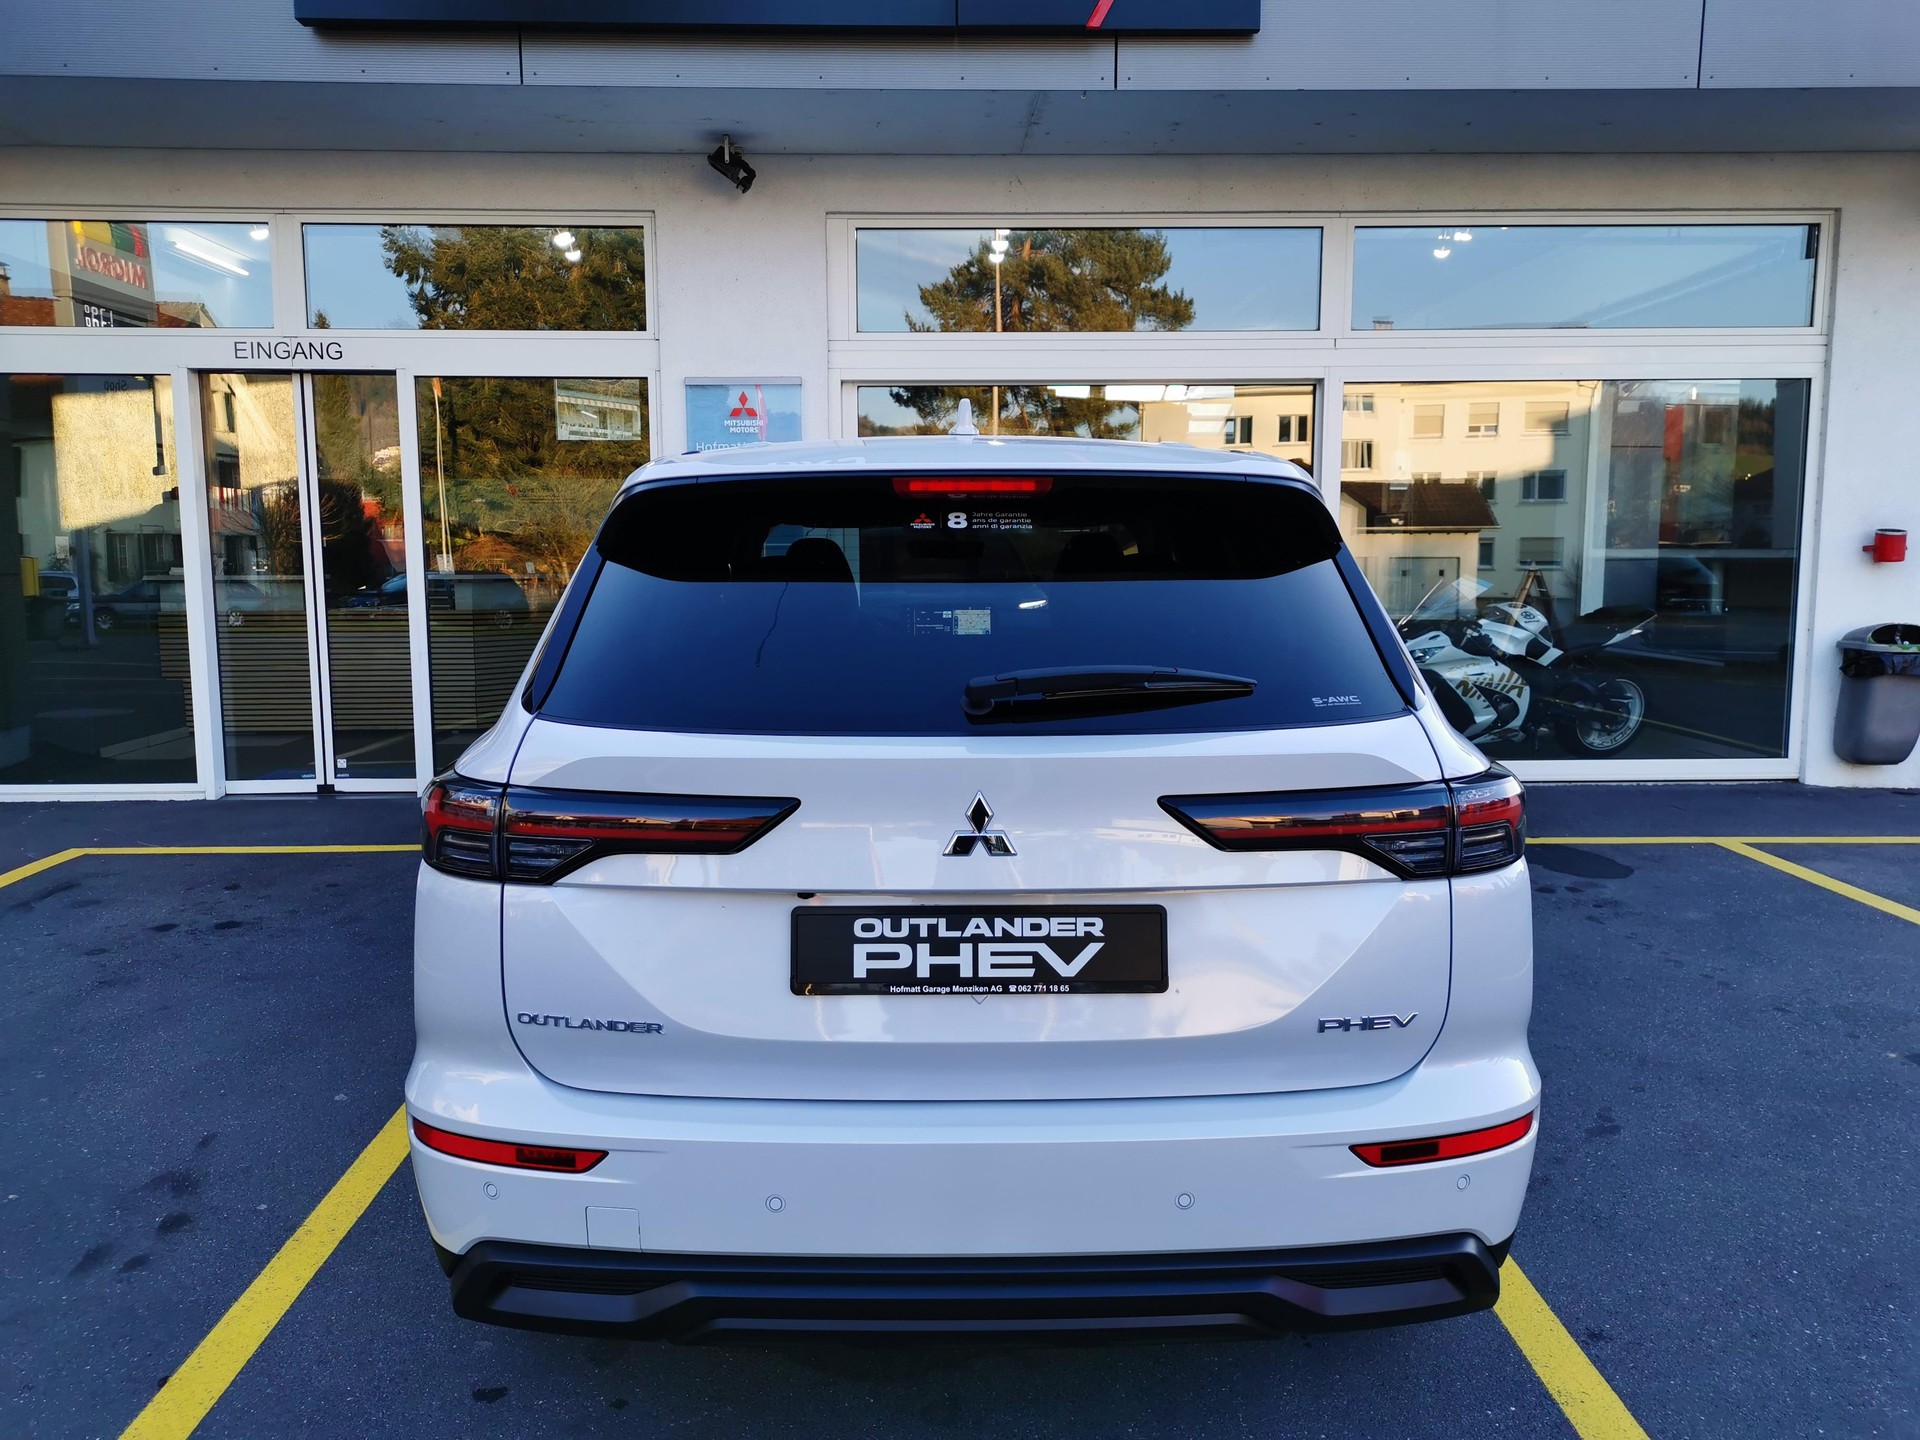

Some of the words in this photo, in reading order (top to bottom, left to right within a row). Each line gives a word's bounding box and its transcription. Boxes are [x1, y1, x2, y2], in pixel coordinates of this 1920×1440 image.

[234, 341, 344, 361] EINGANG
[947, 512, 968, 529] 8
[1000, 517, 1032, 525] garantie
[1311, 695, 1360, 704] S-AWC
[853, 917, 1105, 938] OUTLANDER
[853, 942, 1106, 979] PHEV
[890, 985, 921, 993] Hofmatt
[922, 985, 951, 994] Garage
[952, 985, 989, 993] Menziken
[990, 985, 1003, 993] AG
[517, 1011, 665, 1035] OUTLANDER
[1317, 1011, 1419, 1034] PHEV
